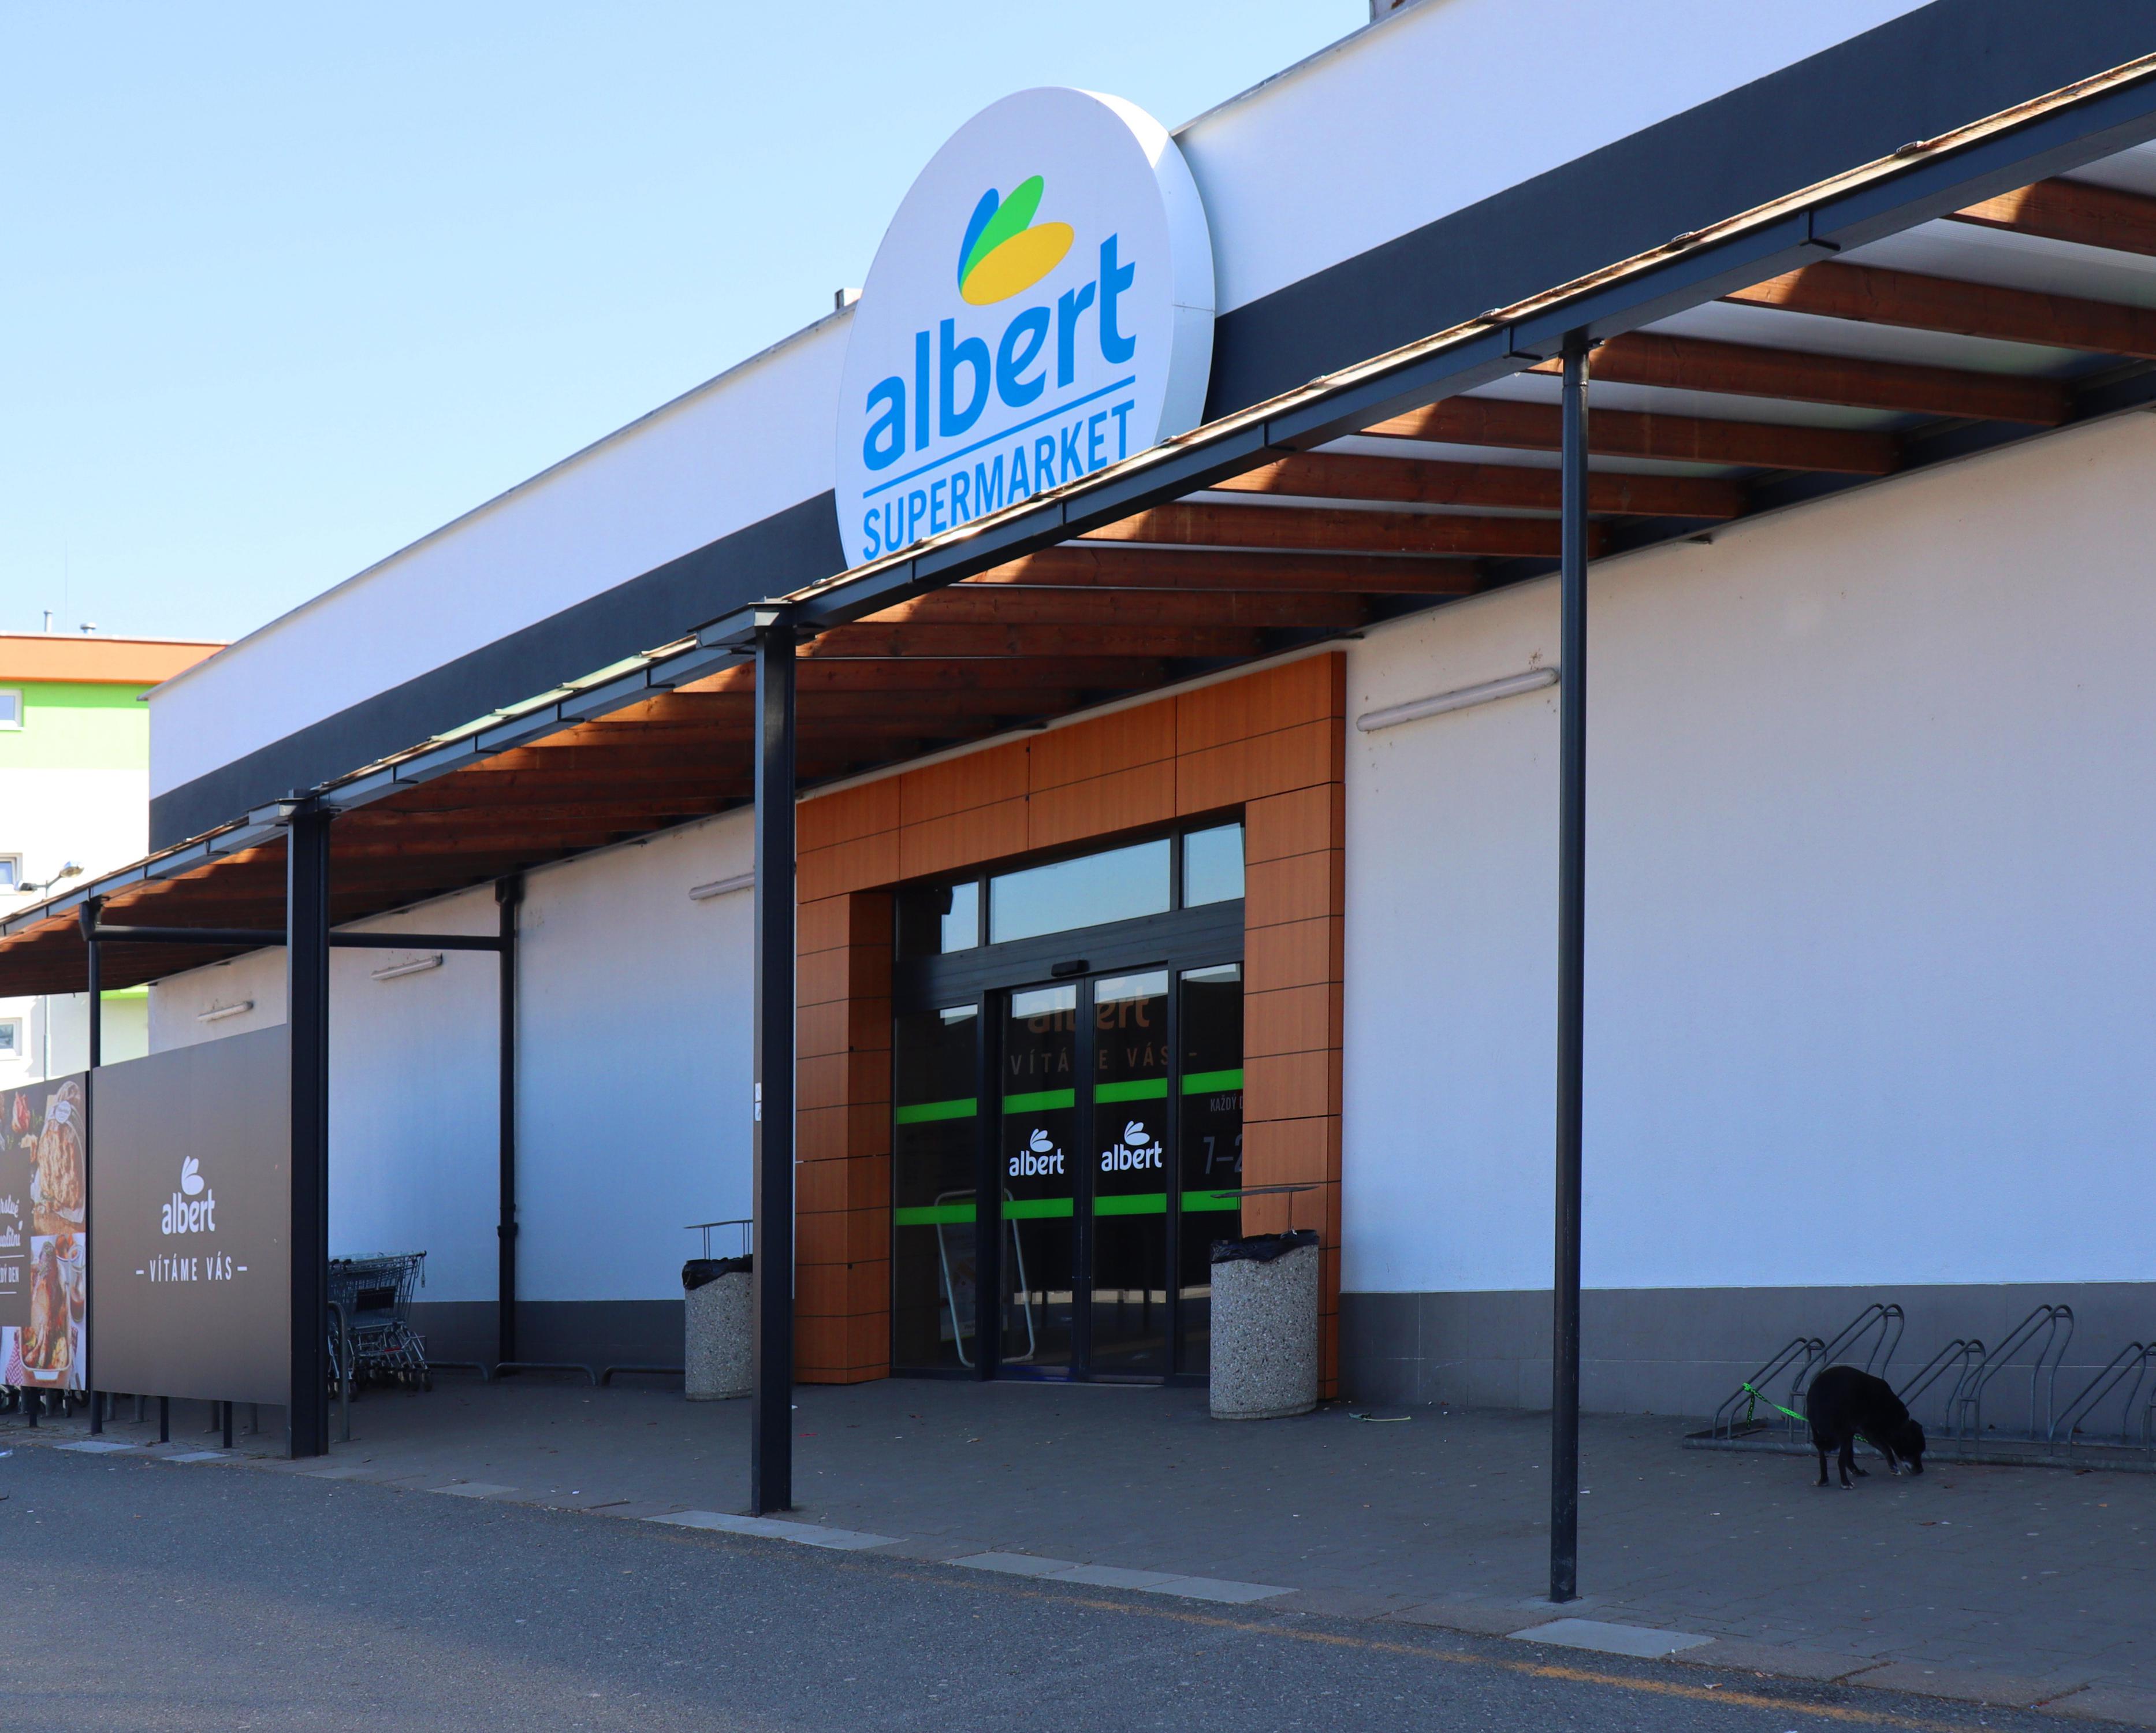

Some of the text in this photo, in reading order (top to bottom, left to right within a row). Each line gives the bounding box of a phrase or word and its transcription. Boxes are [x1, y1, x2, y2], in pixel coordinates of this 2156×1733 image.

[862, 232, 1137, 471] albert
[862, 399, 1135, 561] SUPERMARKET
[1011, 1042, 1168, 1075] VÍTÁE VÁS
[1211, 1094, 1237, 1112] KAŽDÝ
[1009, 1148, 1064, 1177] albert
[1101, 1140, 1163, 1172] albert
[161, 1188, 215, 1235] albert
[150, 1251, 232, 1282] VÍTÁME VÁS
